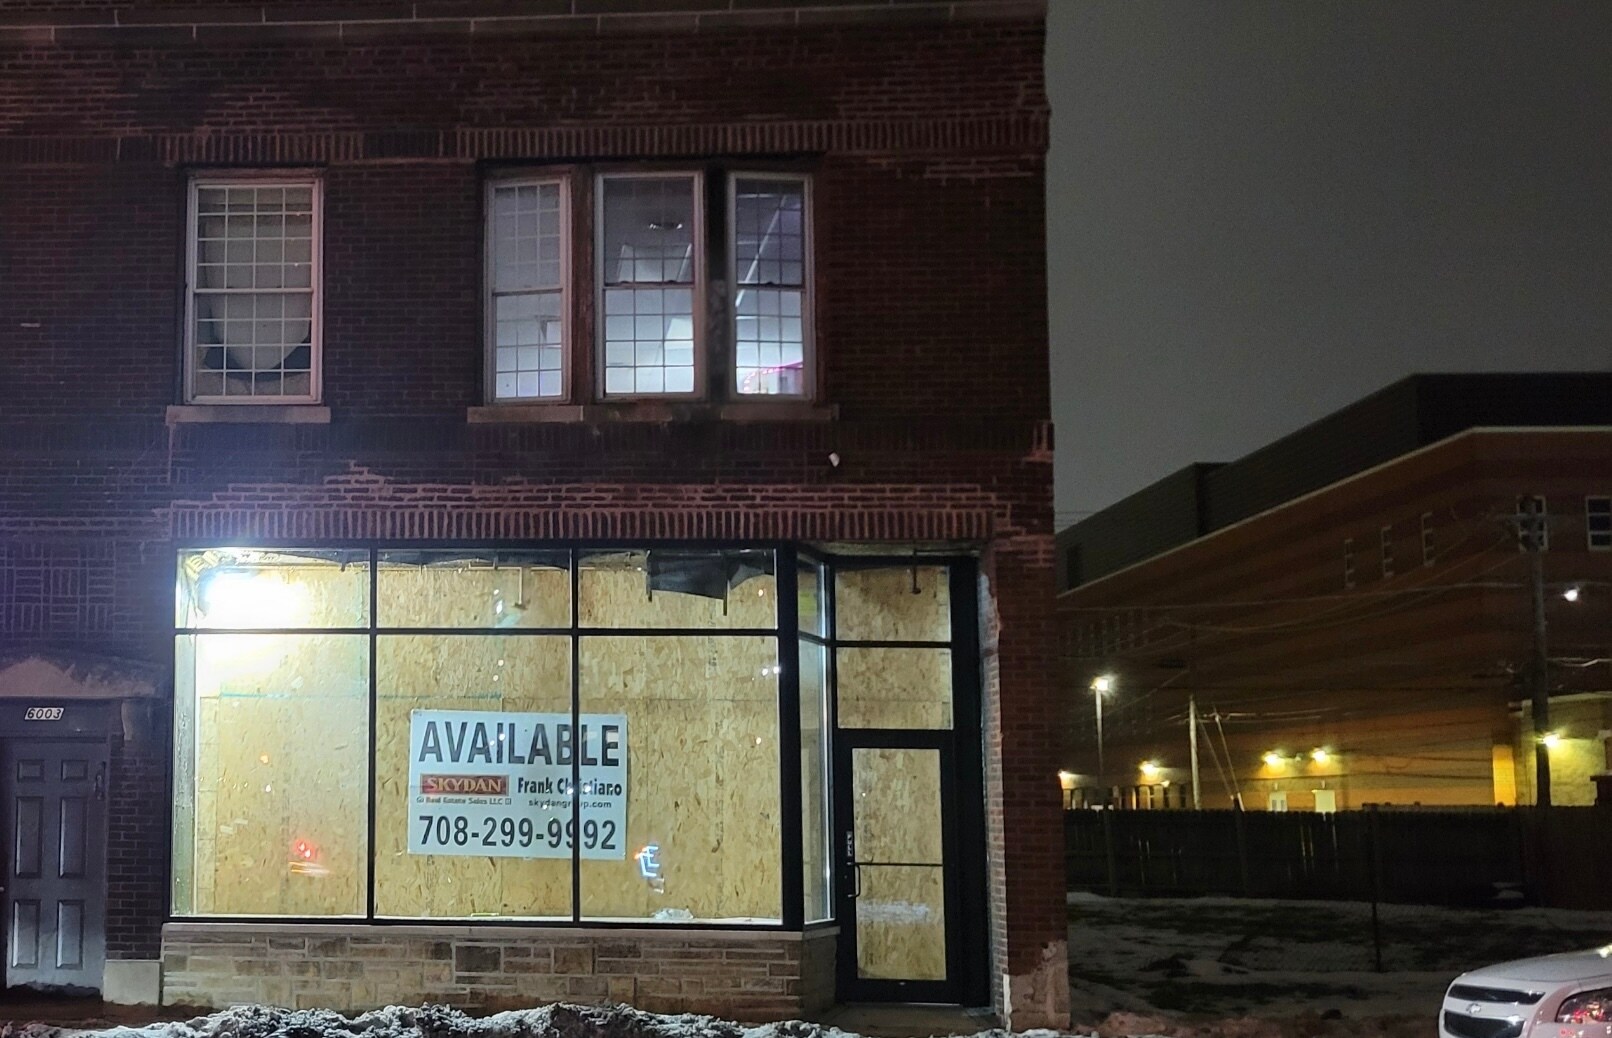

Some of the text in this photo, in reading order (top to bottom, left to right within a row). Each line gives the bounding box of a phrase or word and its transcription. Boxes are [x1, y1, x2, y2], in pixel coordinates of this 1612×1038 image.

[27, 708, 62, 719] 6003
[418, 721, 620, 767] AVAILABLE
[426, 777, 502, 793] SKYDAN
[517, 777, 622, 796] Frank Chistiano
[418, 815, 617, 850] 708-299-9992
